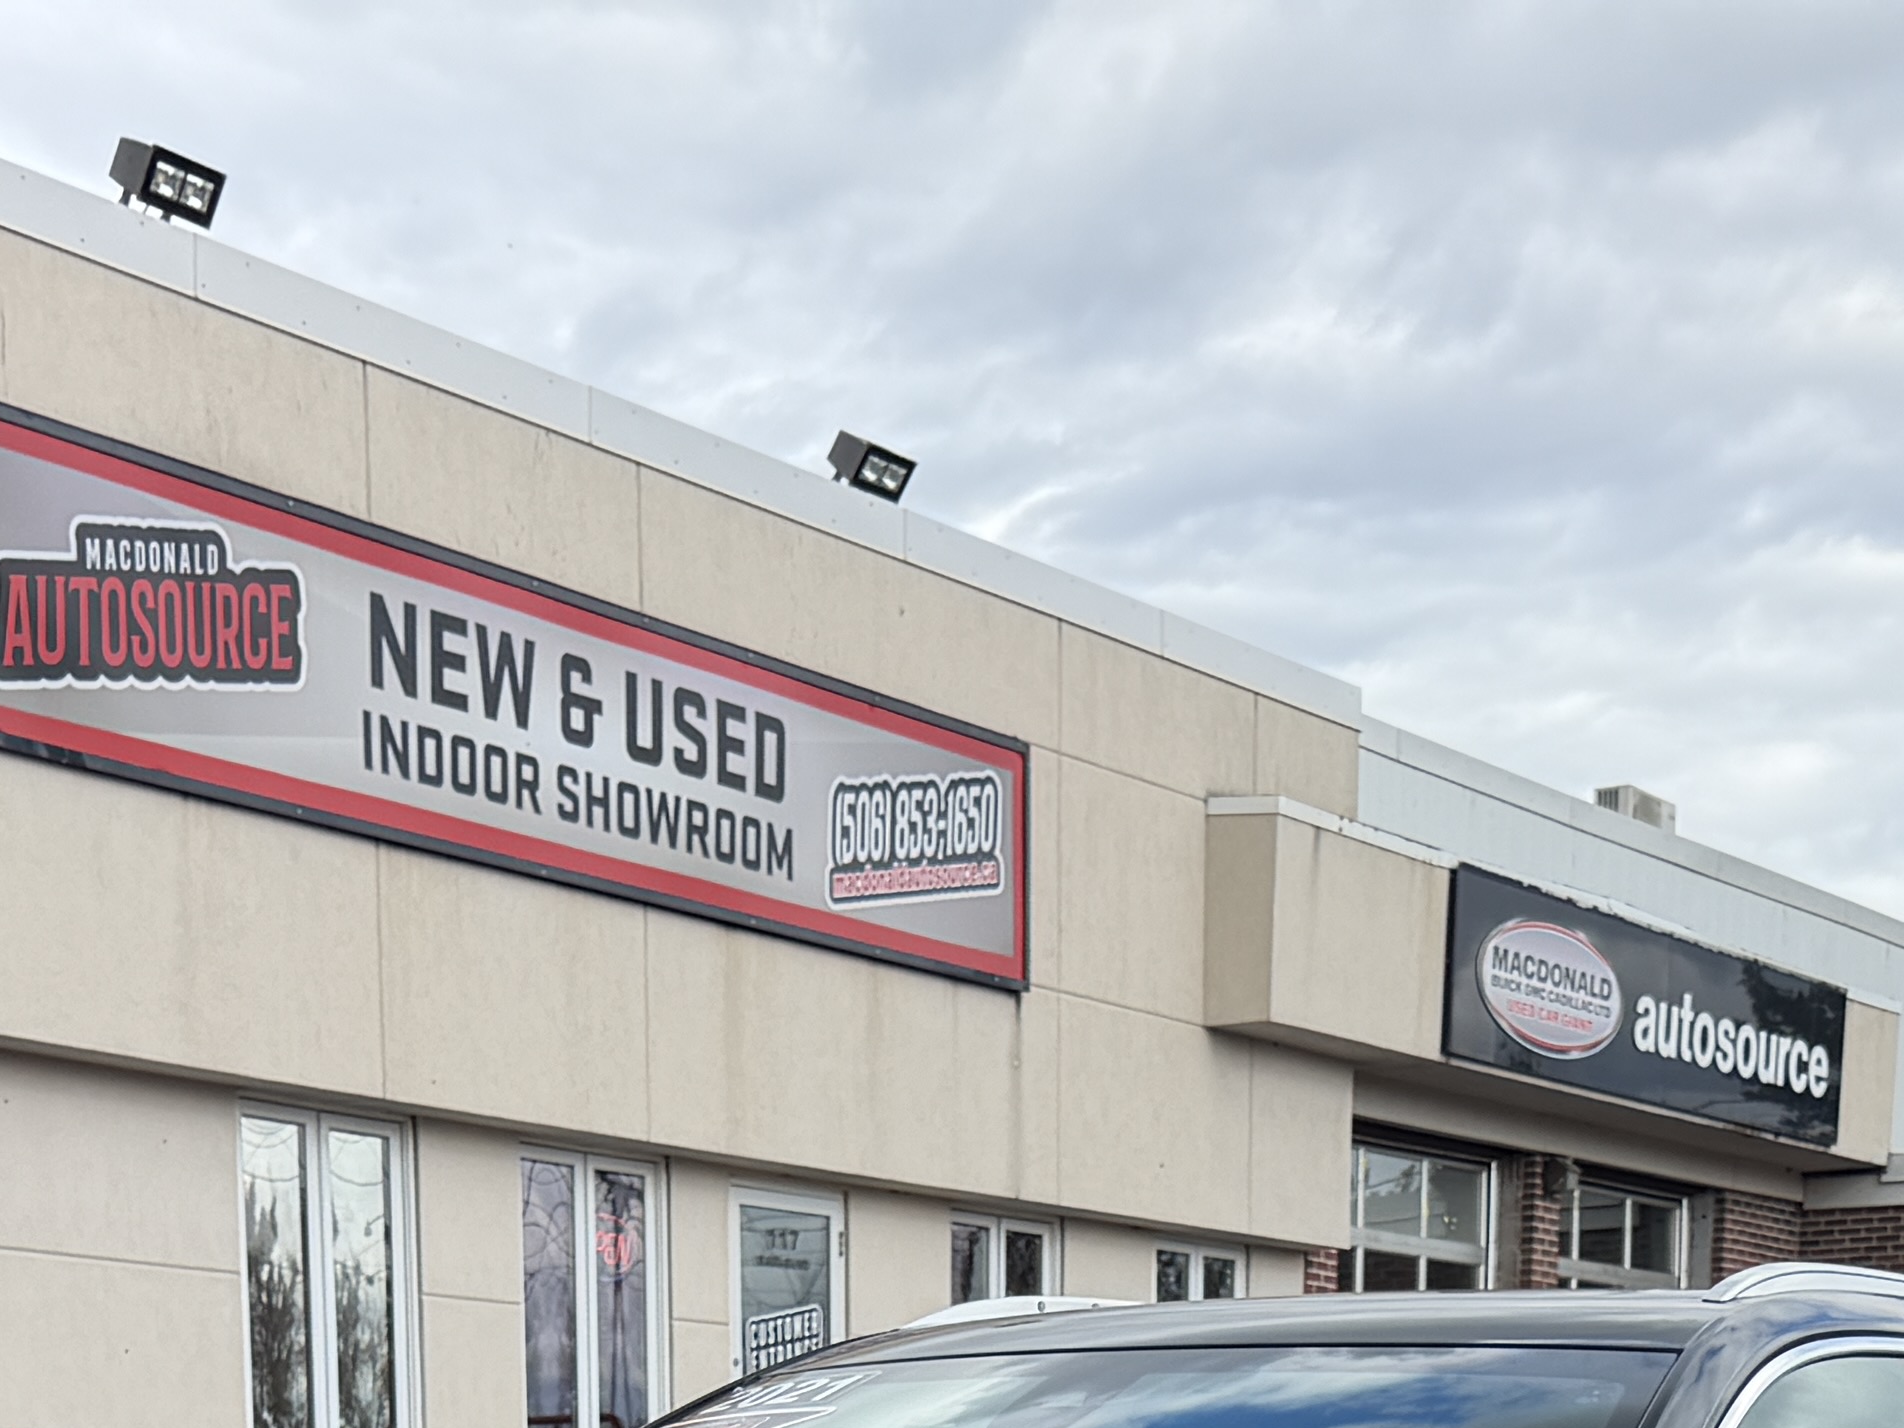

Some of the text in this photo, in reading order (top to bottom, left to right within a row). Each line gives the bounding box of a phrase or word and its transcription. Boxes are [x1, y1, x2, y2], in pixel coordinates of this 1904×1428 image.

[84, 537, 219, 576] MACDONALD
[2, 573, 294, 671] AUTOSOURCE
[369, 590, 786, 805] NEW & USED
[362, 708, 795, 883] INDOOR SHOWROOM
[834, 788, 893, 867] (506)
[1491, 945, 1613, 1002] MACDONALD
[1633, 991, 1831, 1099] autosource
[750, 1310, 818, 1349] CUSTOMER
[698, 1374, 864, 1415] 2021
